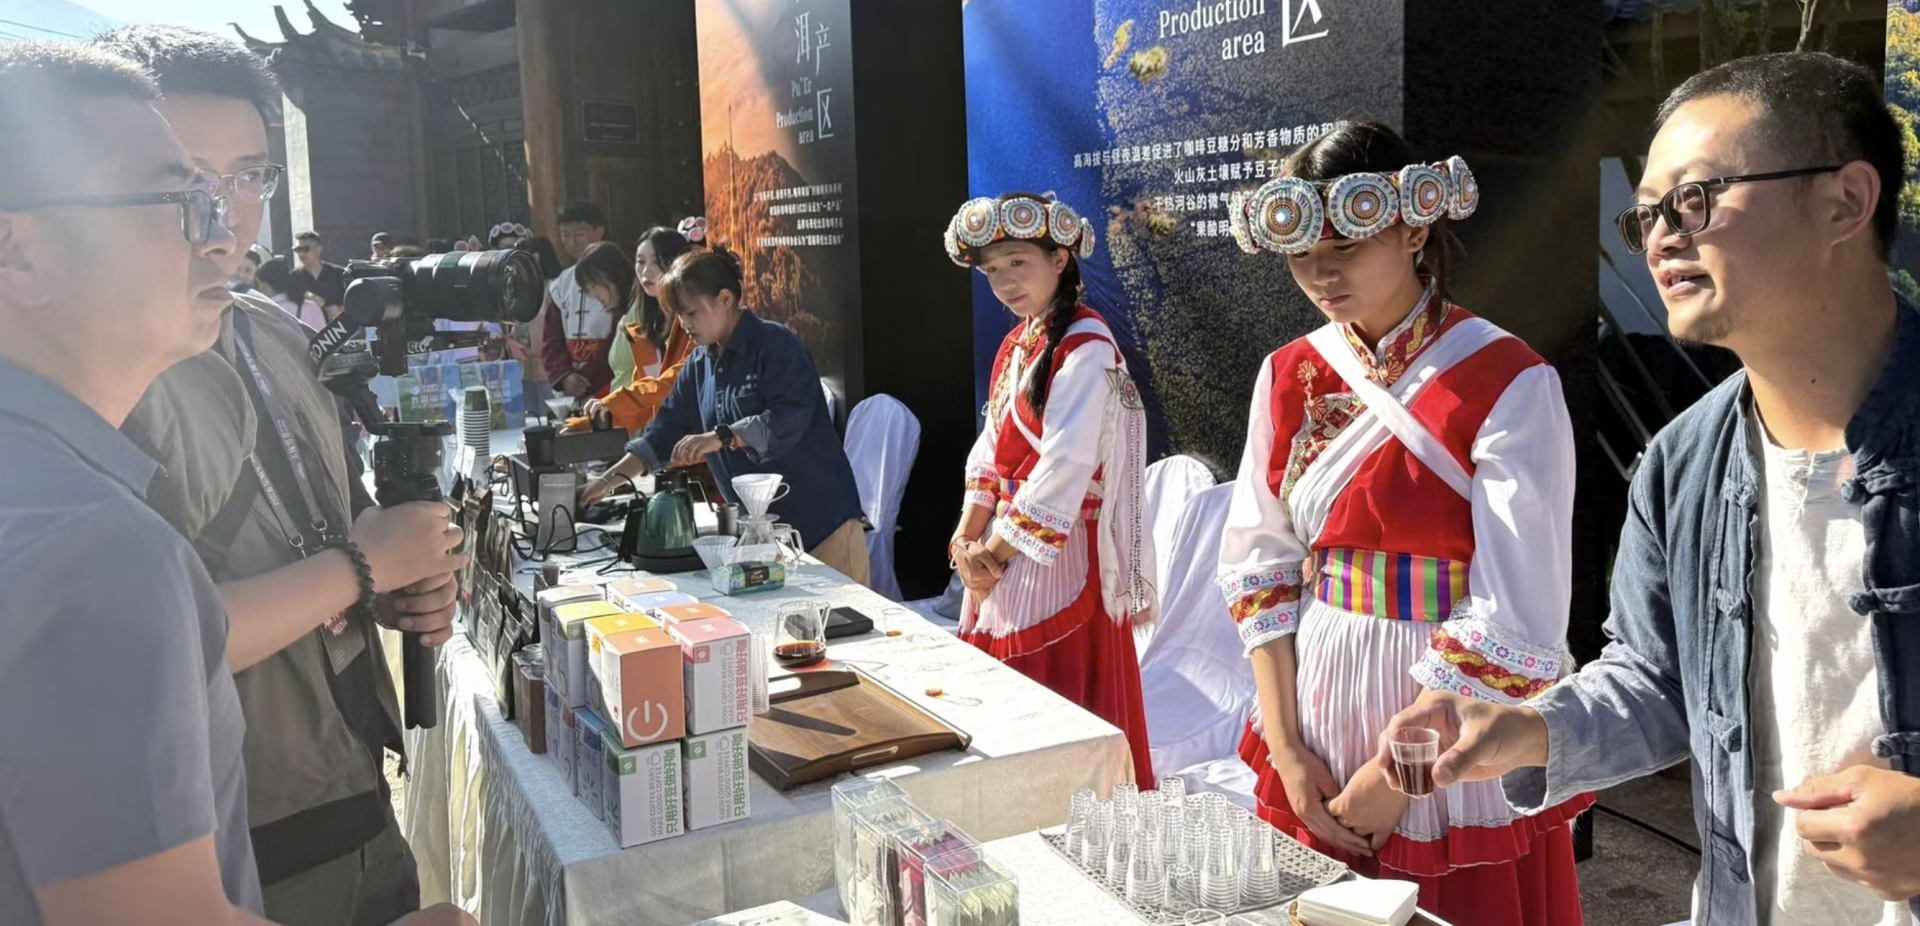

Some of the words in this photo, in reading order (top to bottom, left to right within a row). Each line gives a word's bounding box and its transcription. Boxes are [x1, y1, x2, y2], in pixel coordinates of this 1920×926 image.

[794, 0, 812, 64] 洱
[1159, 0, 1266, 39] Production
[1221, 30, 1266, 60] area
[776, 106, 814, 129] Production
[798, 129, 815, 144] area
[1174, 158, 1288, 185] 火山灰土壤赋予豆子
[1190, 219, 1235, 238] “果酸明
[309, 321, 348, 366] RONIN
